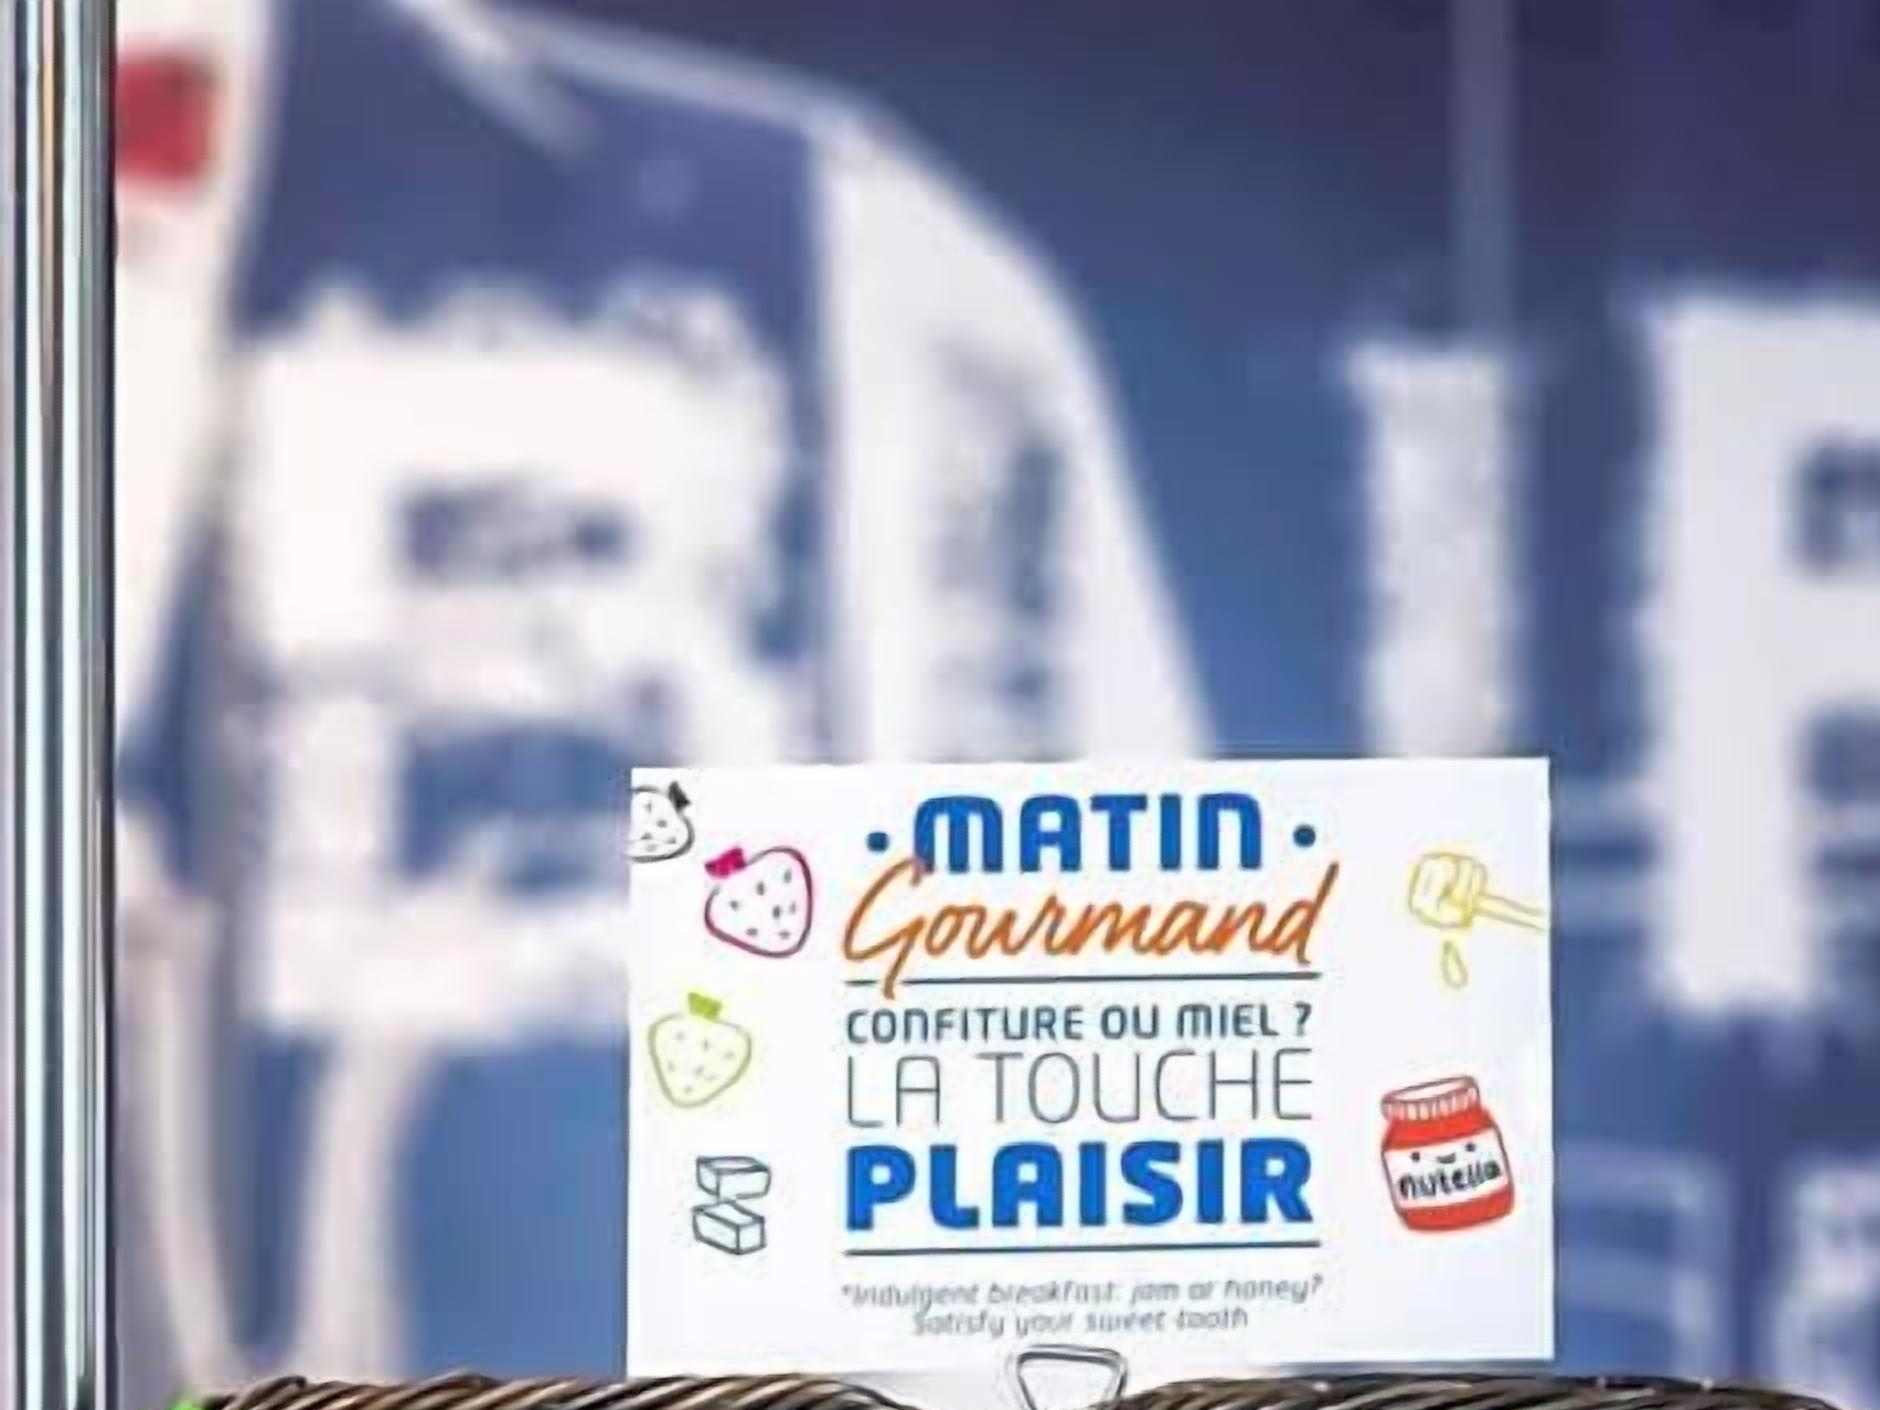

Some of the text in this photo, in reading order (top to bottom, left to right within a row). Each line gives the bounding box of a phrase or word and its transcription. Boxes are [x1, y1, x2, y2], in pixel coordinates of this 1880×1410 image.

[913, 792, 1263, 873] MATIN
[842, 855, 1340, 999] Gourmand
[845, 1004, 1085, 1045] CONFITURE
[1101, 1004, 1160, 1041] OU
[1176, 1003, 1279, 1038] MIEL
[847, 1047, 1314, 1129] LA TOUCHE
[845, 1137, 1315, 1232] PLAISIR
